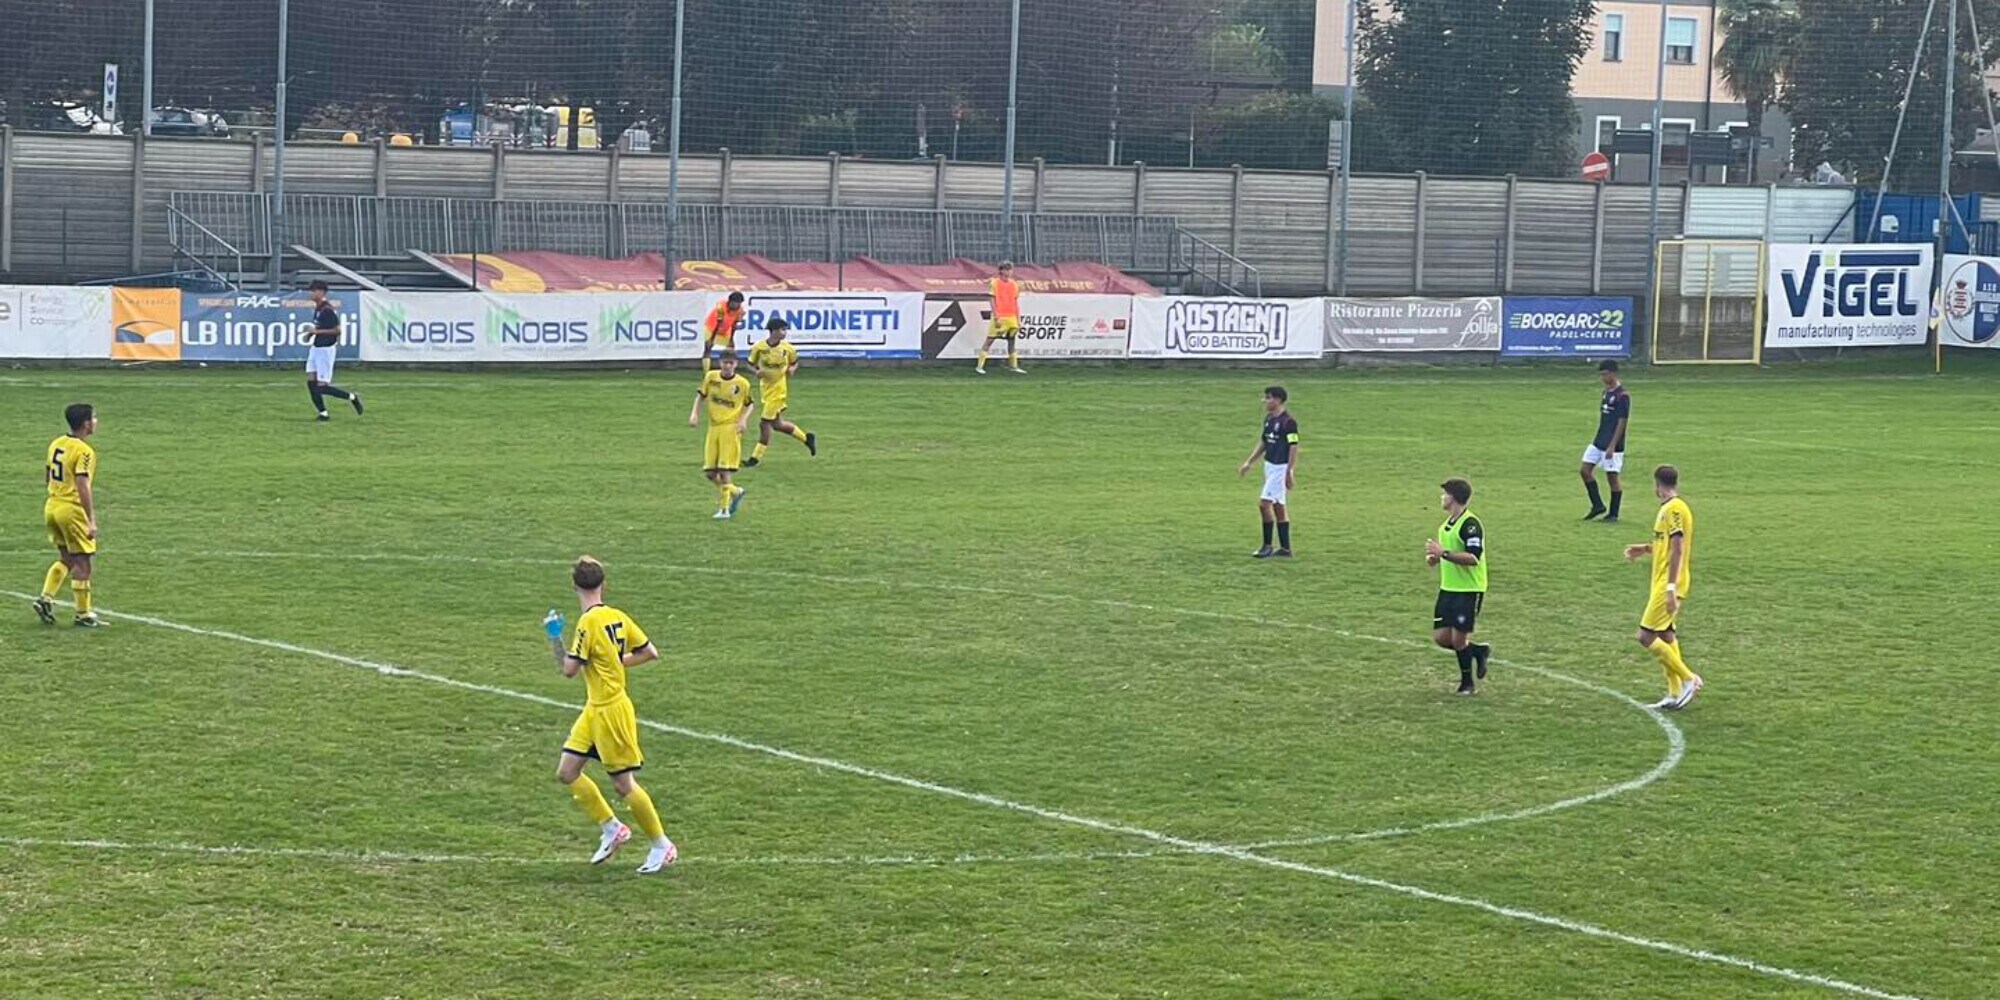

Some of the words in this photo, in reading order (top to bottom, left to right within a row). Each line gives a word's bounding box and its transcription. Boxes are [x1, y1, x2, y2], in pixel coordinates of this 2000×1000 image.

[236, 296, 281, 308] FAAC
[1331, 302, 1403, 318] Ristorante
[1408, 303, 1462, 318] Pizzeria
[182, 320, 217, 345] LB
[224, 312, 358, 356] impiati
[387, 321, 475, 343] NOBIS
[502, 321, 588, 343] NOBIS
[615, 320, 698, 342] NOBIS
[1017, 327, 1066, 340] SPORT
[1166, 300, 1288, 352] ROSTAGNO
[1777, 323, 1854, 341] manufacturing
[1856, 322, 1917, 340] technologies
[1188, 335, 1209, 348] GIO
[1212, 335, 1267, 348] BATTISTA
[51, 448, 64, 482] 5
[605, 621, 625, 655] 15
